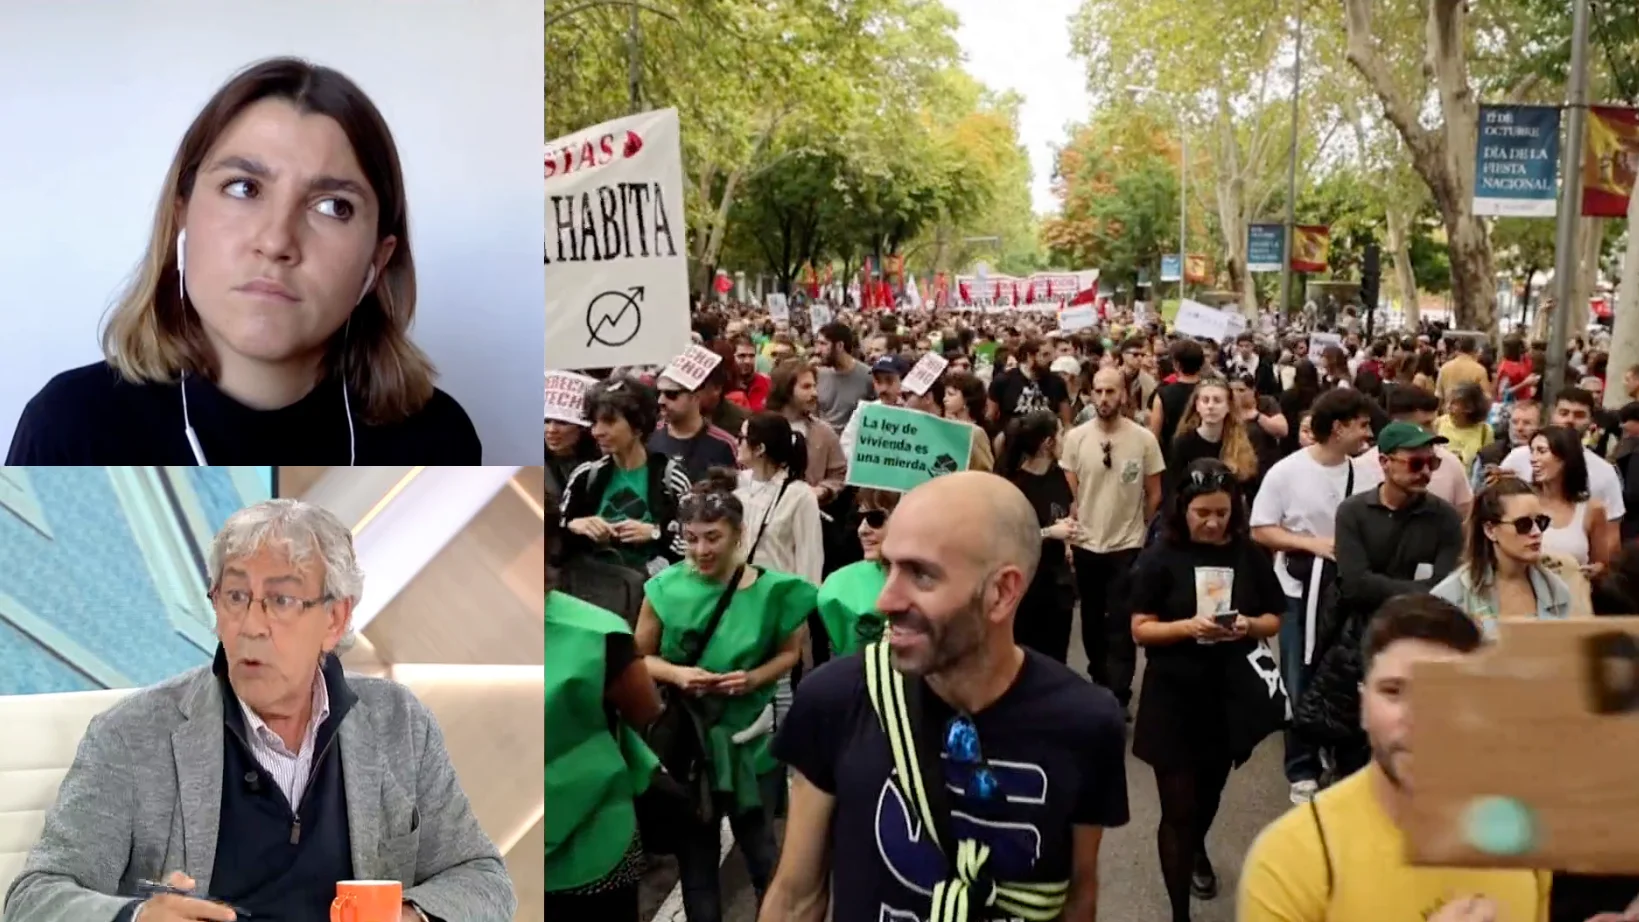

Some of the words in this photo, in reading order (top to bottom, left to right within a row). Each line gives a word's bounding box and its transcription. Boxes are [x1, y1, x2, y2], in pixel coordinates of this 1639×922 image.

[1485, 126, 1540, 137] OCTUBRE
[1484, 144, 1507, 159] DÍA
[1510, 147, 1528, 160] DE
[1530, 148, 1548, 160] LA
[1483, 161, 1526, 174] FIESTA
[1482, 177, 1551, 190] NACIONAL
[551, 182, 677, 262] HABITA
[863, 416, 878, 429] La
[881, 419, 899, 435] ley
[902, 424, 918, 435] de
[860, 435, 912, 452] vivienda
[915, 444, 929, 455] es
[857, 453, 880, 464] una
[883, 456, 926, 471] mierda
